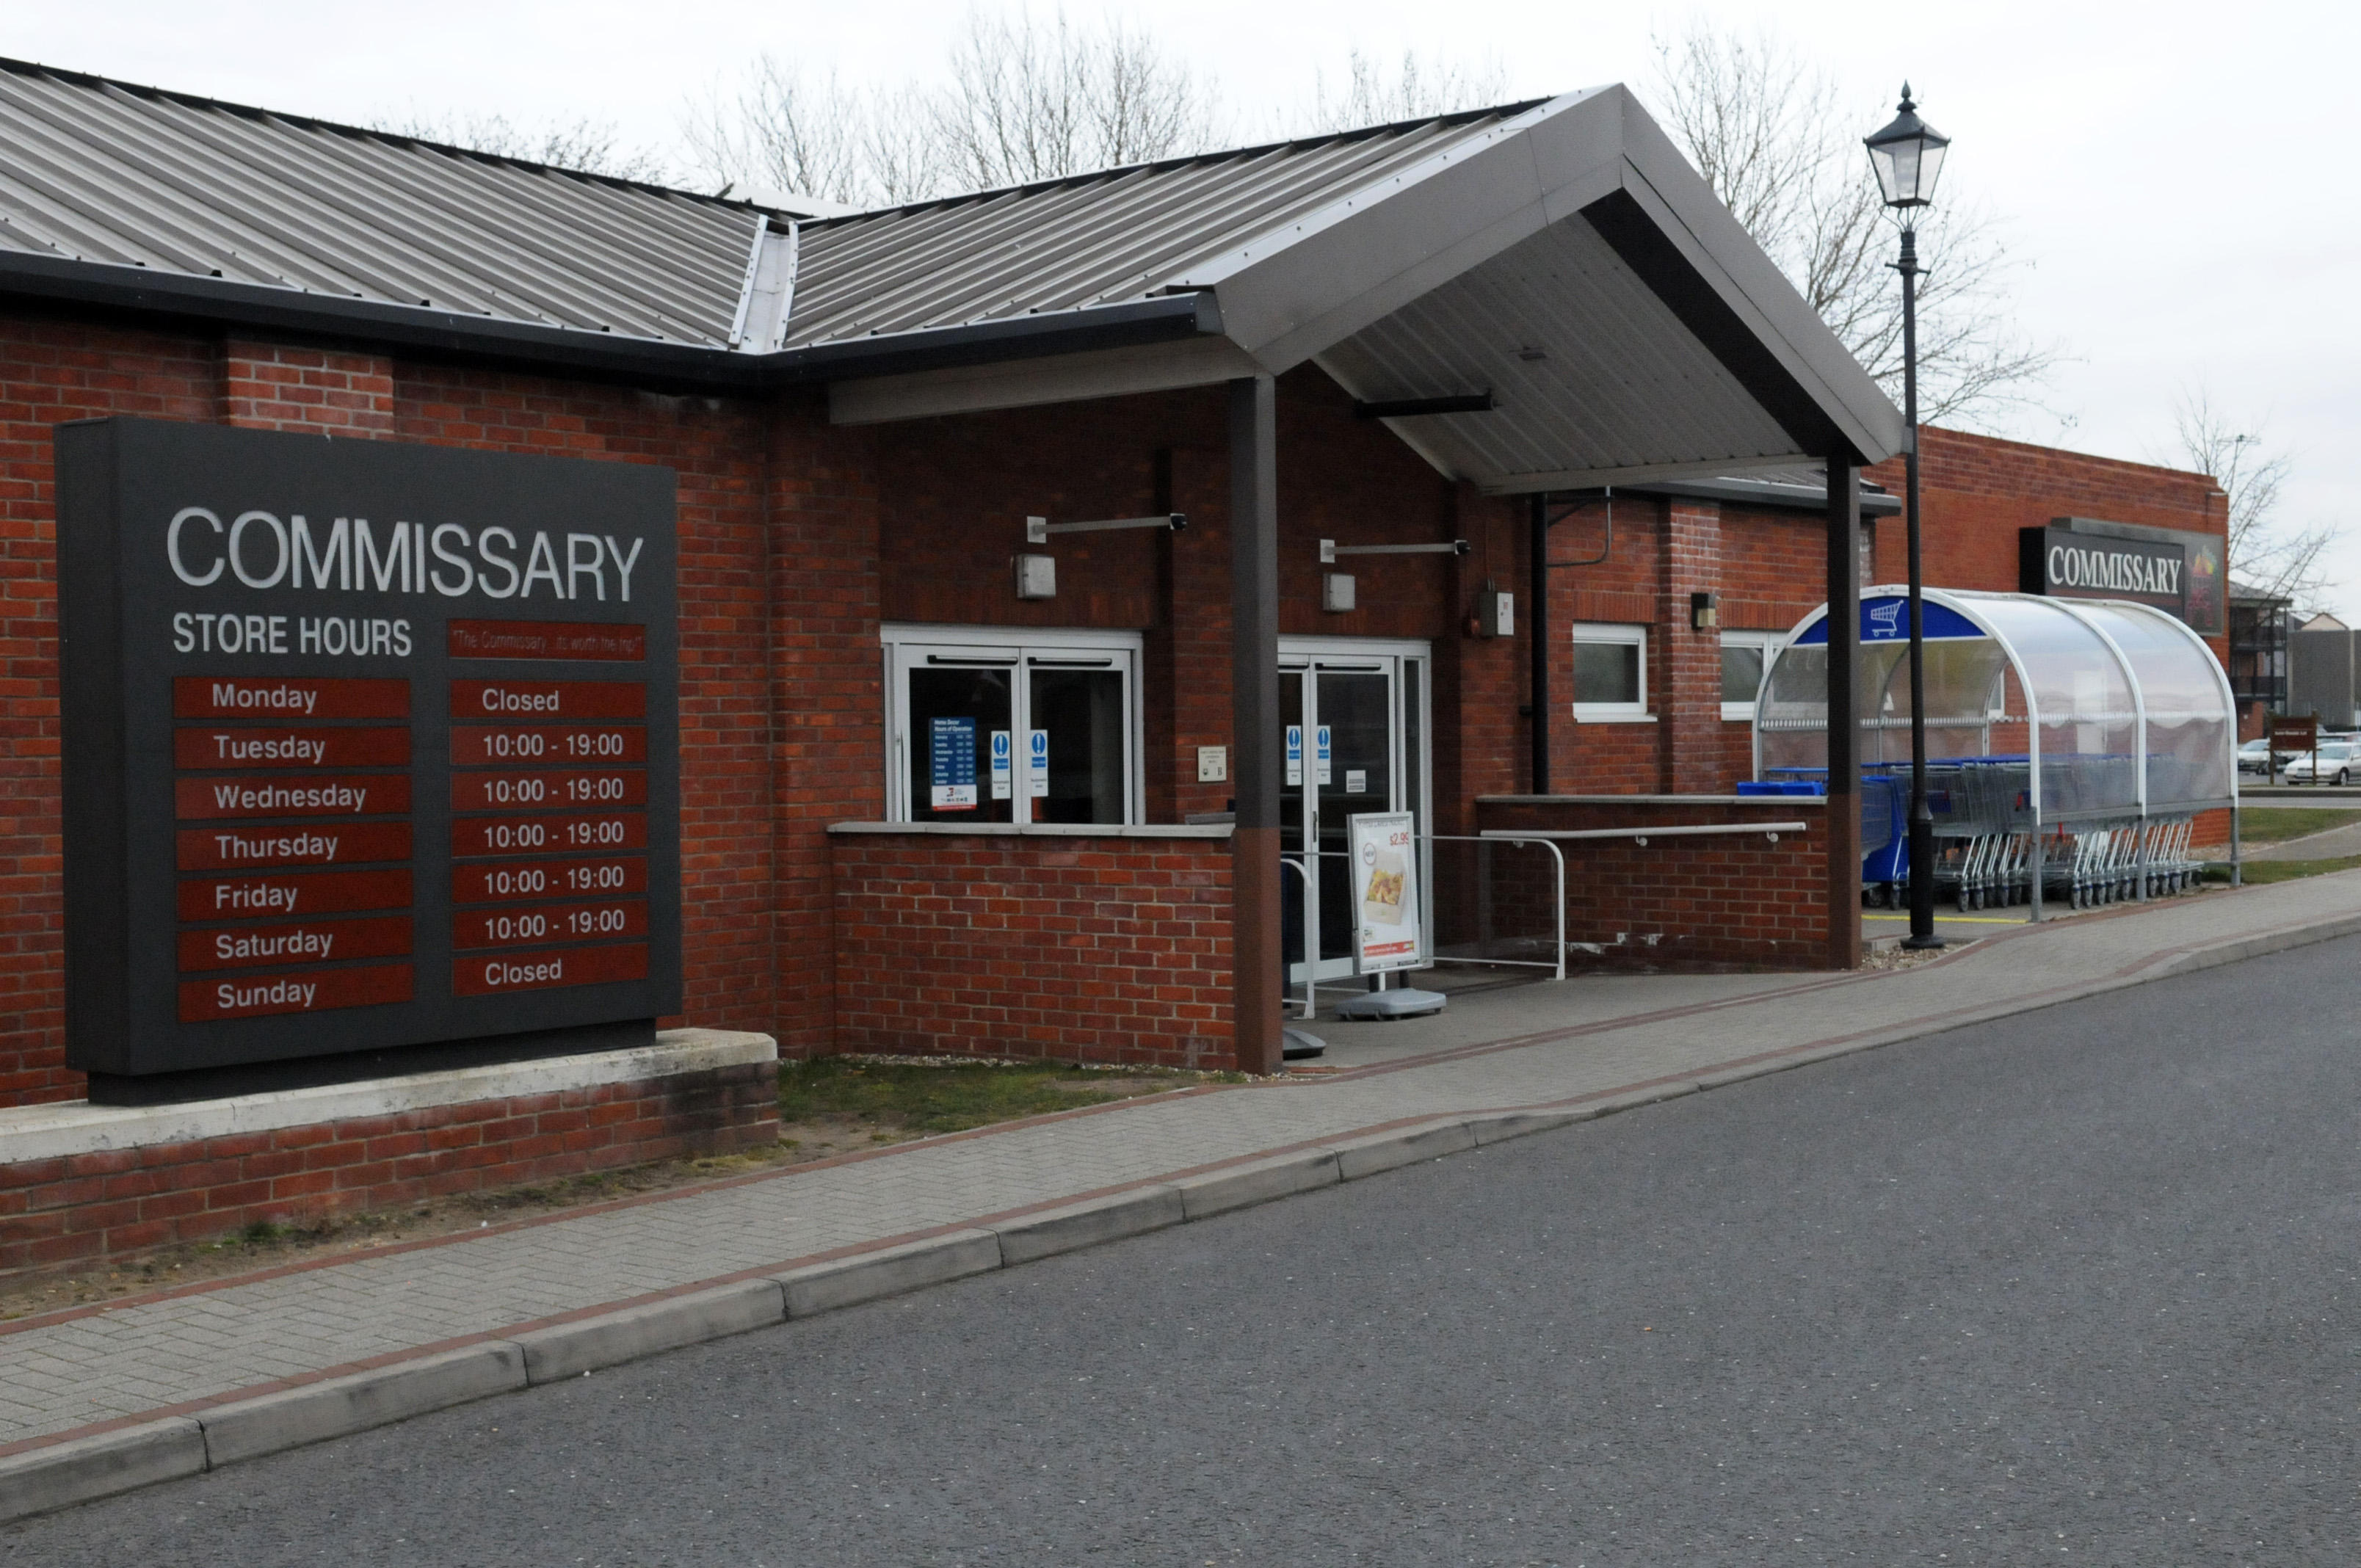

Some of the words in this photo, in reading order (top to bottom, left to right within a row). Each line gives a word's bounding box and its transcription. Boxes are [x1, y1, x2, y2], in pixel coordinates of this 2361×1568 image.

[167, 507, 644, 602] COMMISSARY
[2048, 545, 2182, 595] COMMISSARY
[173, 612, 289, 654] STORE
[300, 617, 413, 657] HOURS
[213, 684, 316, 714] Monday
[482, 689, 559, 711] Closed
[214, 736, 324, 763] Tuesday
[484, 734, 544, 756] 10:00
[567, 734, 623, 755] 19:00
[214, 784, 366, 811] Wednesday
[485, 780, 544, 802] 10:00
[567, 778, 623, 799] 19:00
[215, 833, 338, 860] Thursday
[485, 824, 545, 847] 10:00
[567, 821, 624, 843] 19:00
[485, 870, 545, 893] 10:00
[568, 866, 624, 888] 19:00
[216, 885, 297, 911] Friday
[486, 915, 545, 939] 10:00
[569, 910, 625, 932] 19:00
[217, 931, 333, 958] Saturday
[485, 959, 562, 985] Closed
[218, 981, 316, 1008] Sunday
